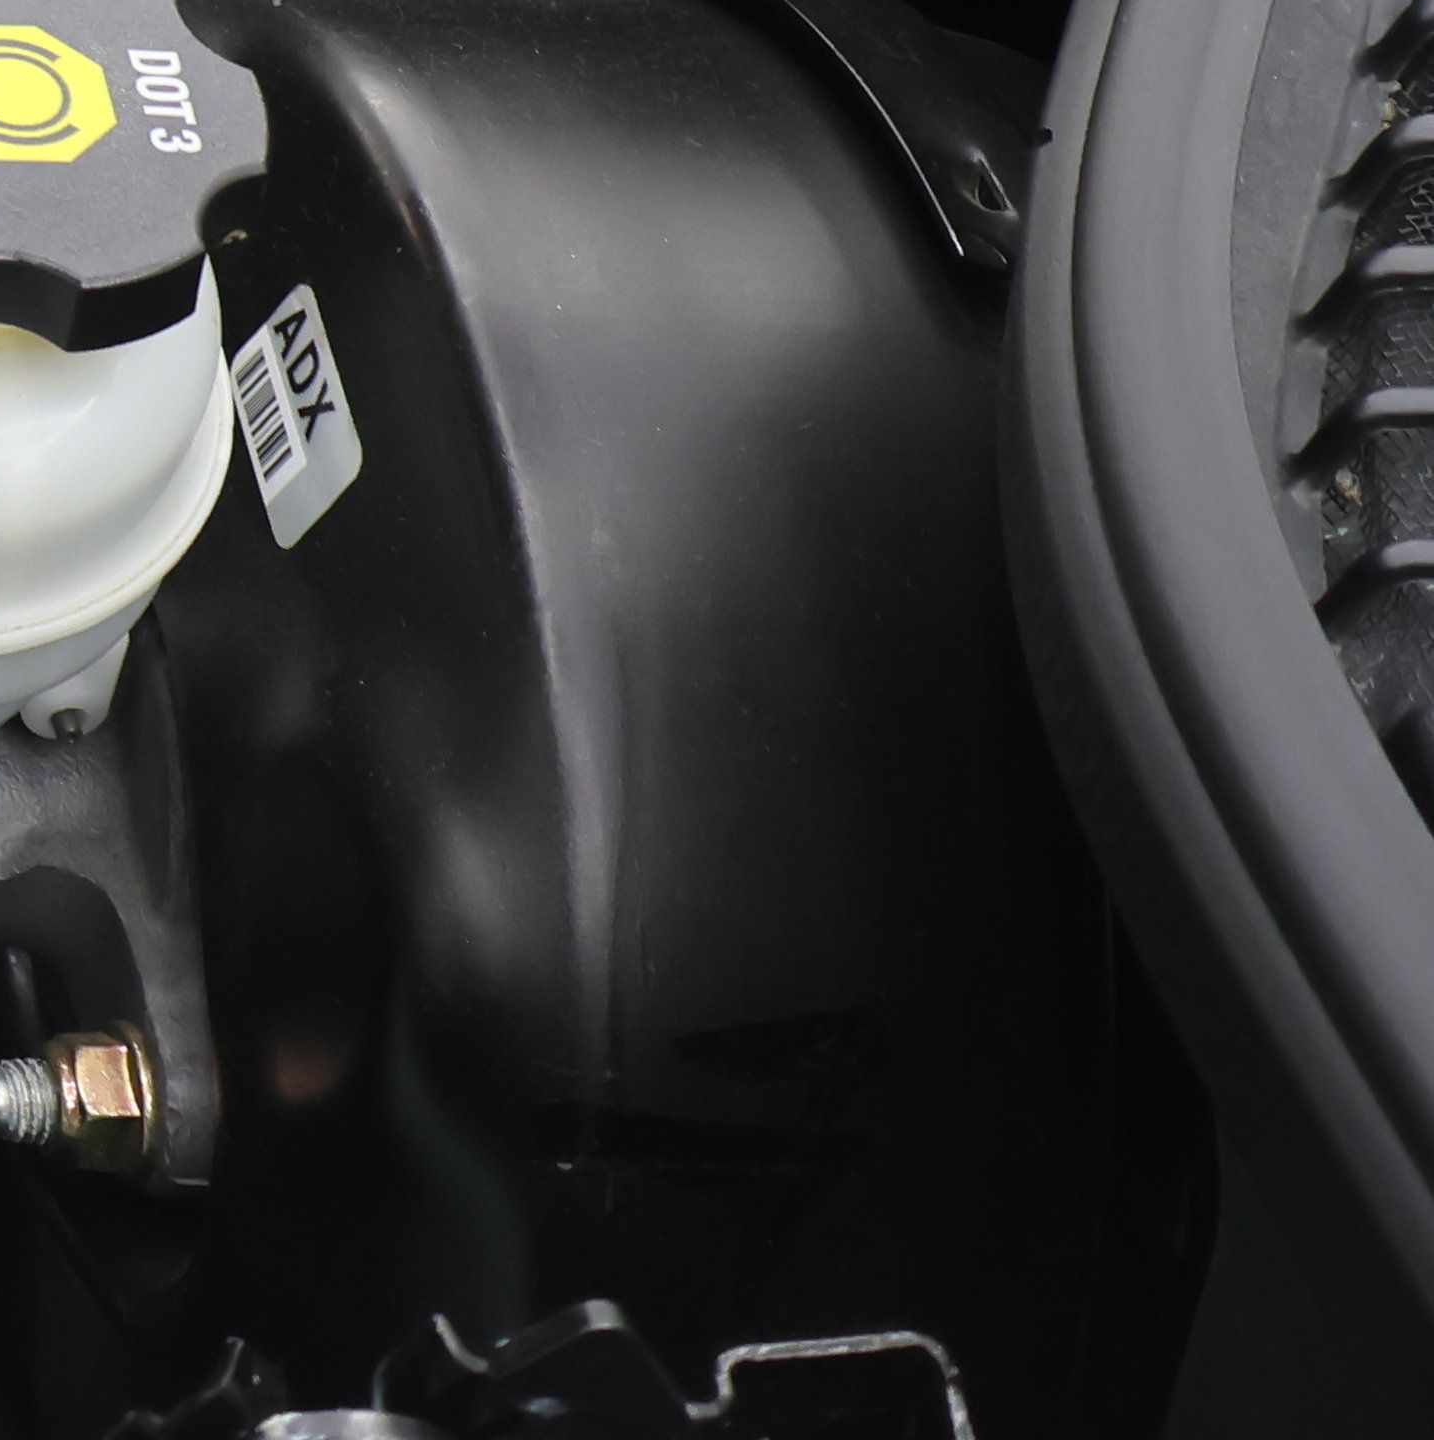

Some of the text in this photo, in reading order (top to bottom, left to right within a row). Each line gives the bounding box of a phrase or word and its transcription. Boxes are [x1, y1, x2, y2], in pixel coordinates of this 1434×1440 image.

[126, 48, 202, 154] DOT 3
[274, 308, 335, 443] ADX
